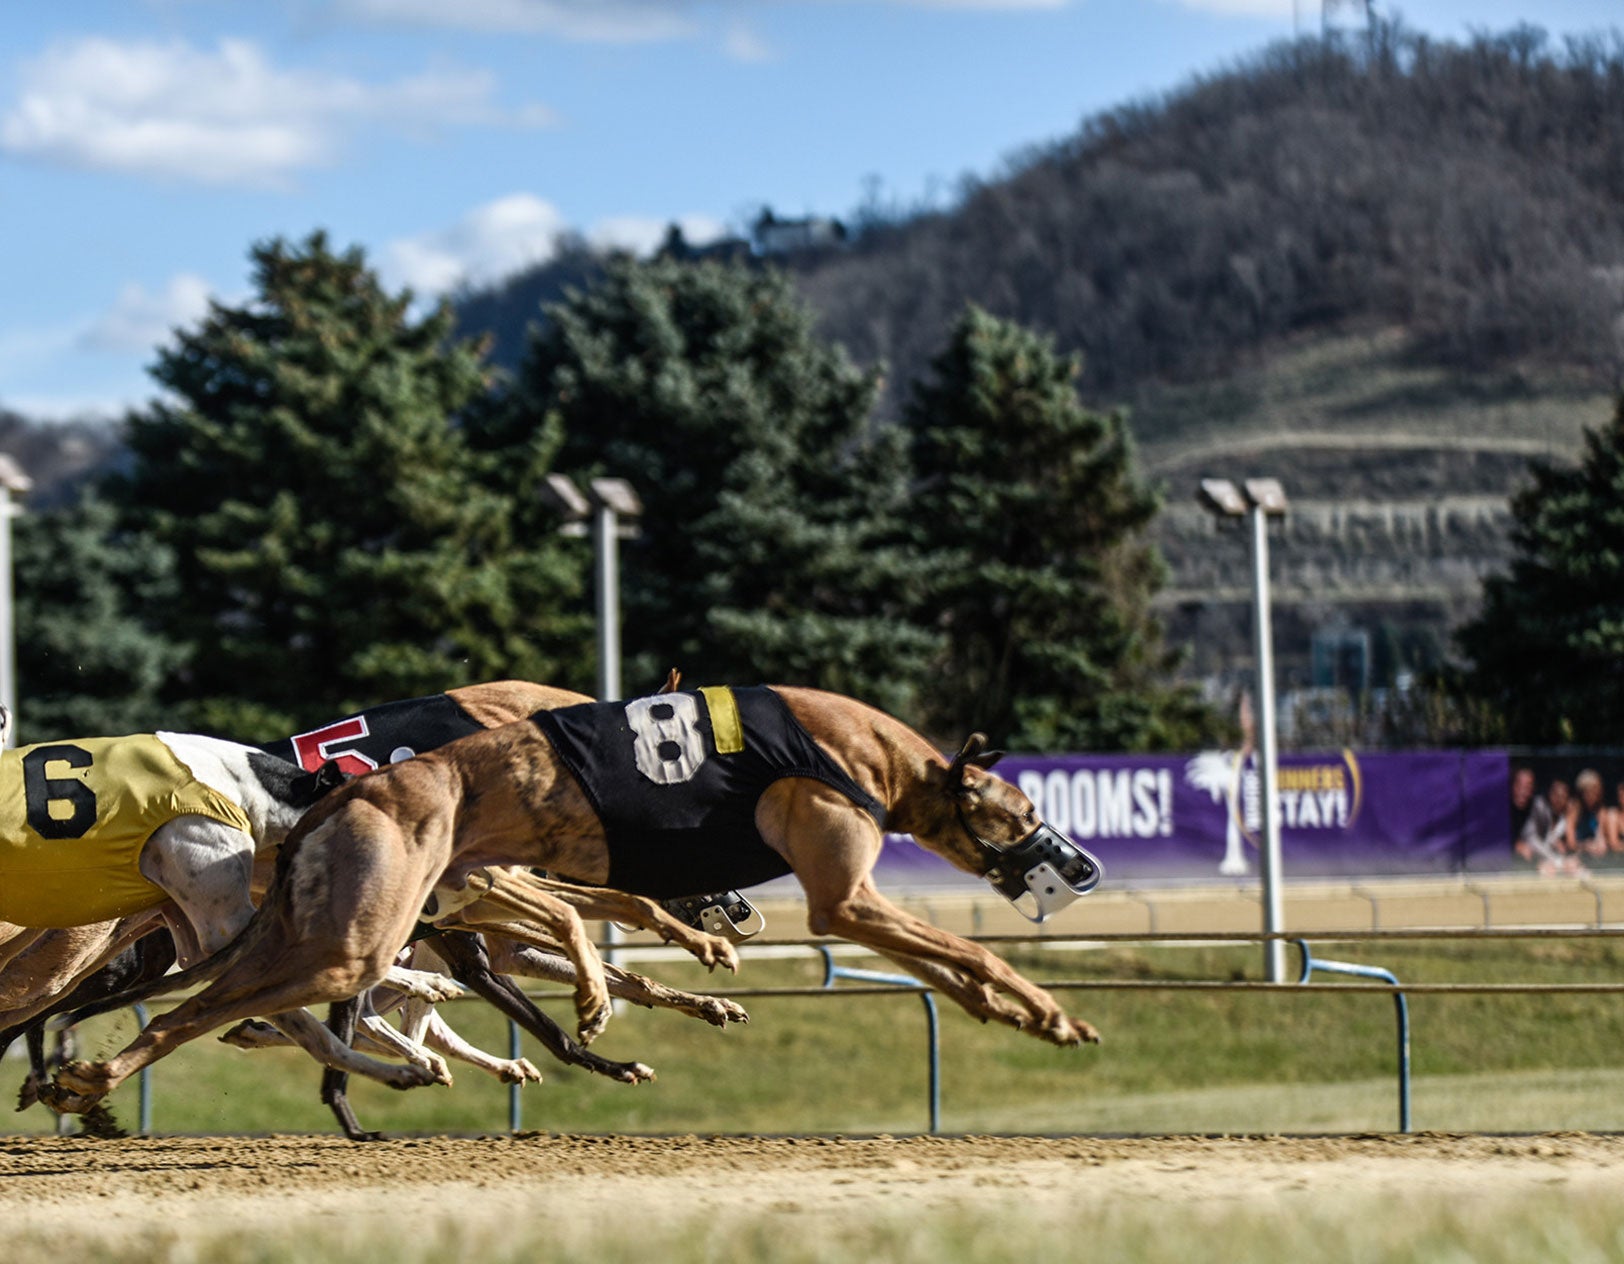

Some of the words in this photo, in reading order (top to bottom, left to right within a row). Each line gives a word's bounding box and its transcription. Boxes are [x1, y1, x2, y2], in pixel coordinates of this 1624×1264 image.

[290, 715, 378, 775] 5
[625, 692, 706, 785] 8
[22, 744, 97, 840] 6
[1277, 766, 1345, 790] INNERS
